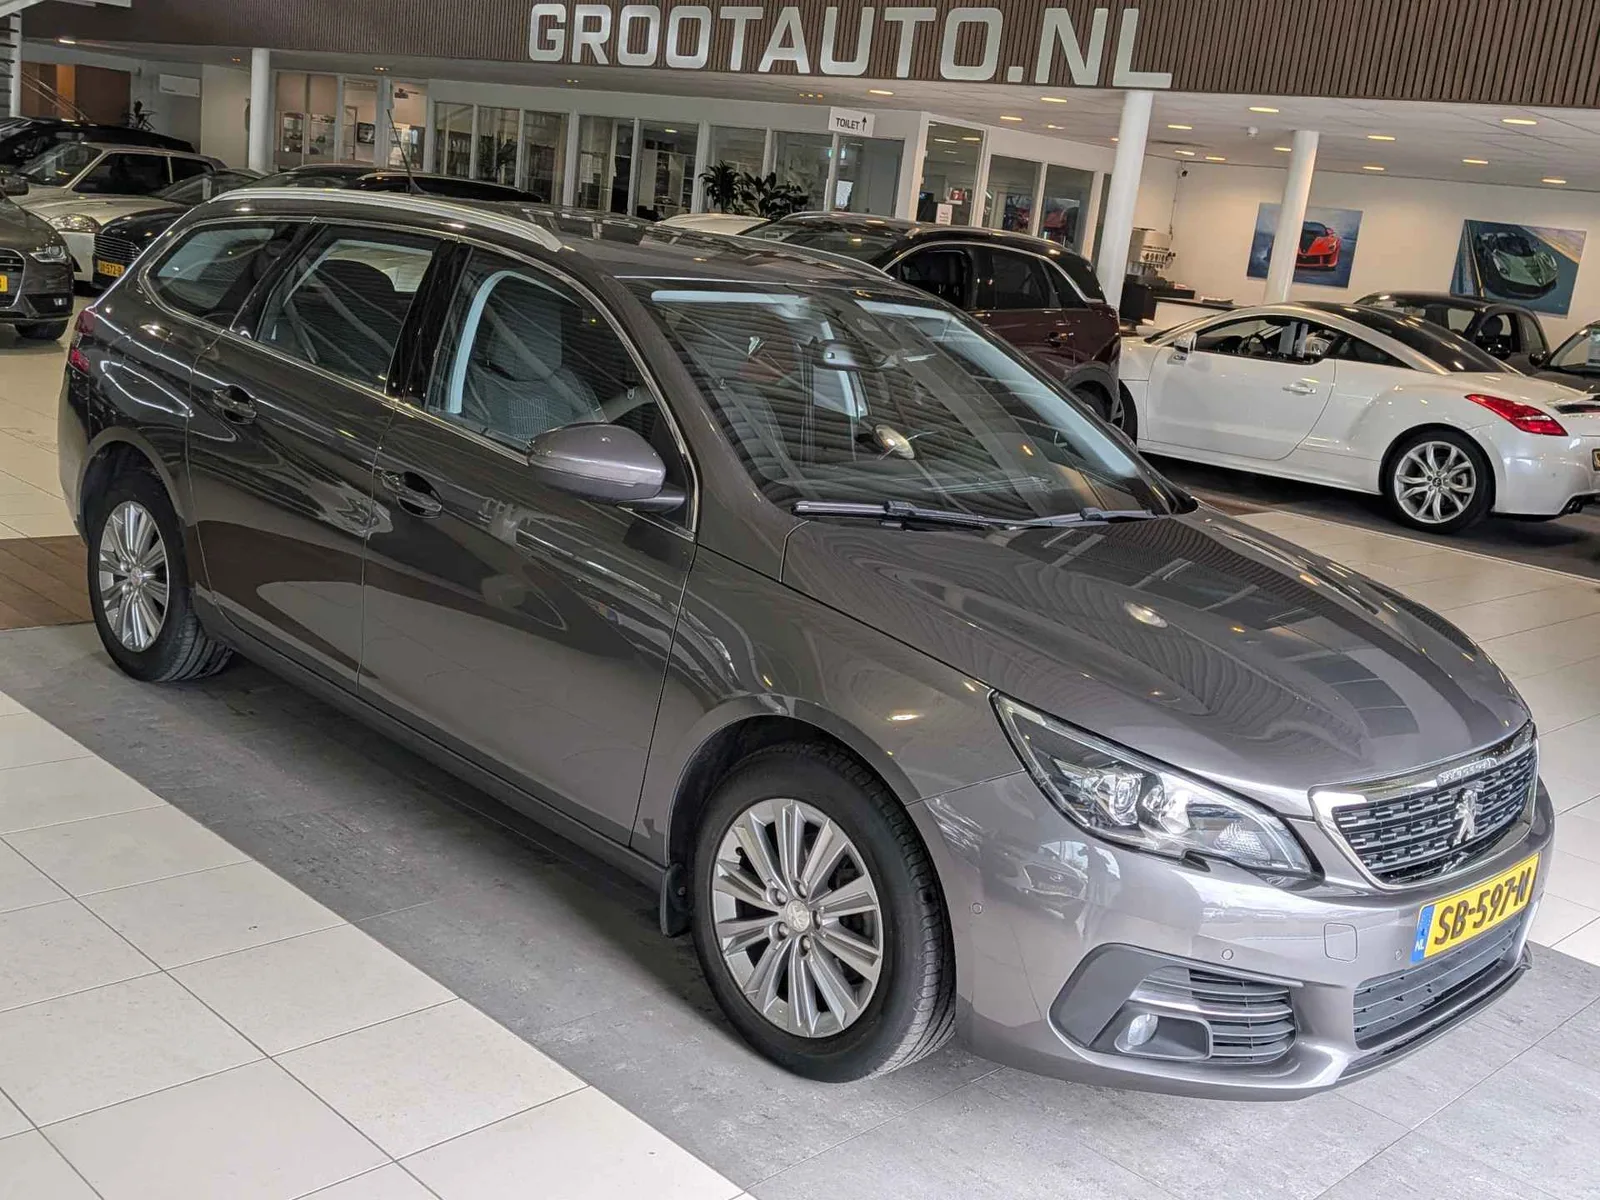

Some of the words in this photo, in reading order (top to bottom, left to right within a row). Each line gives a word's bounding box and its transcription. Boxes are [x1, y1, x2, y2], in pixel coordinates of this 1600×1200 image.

[528, 3, 1173, 88] GROOTAUTO.NL
[835, 117, 860, 130] TOILET
[1434, 866, 1532, 946] SB-597-N
[1414, 940, 1425, 952] NL
